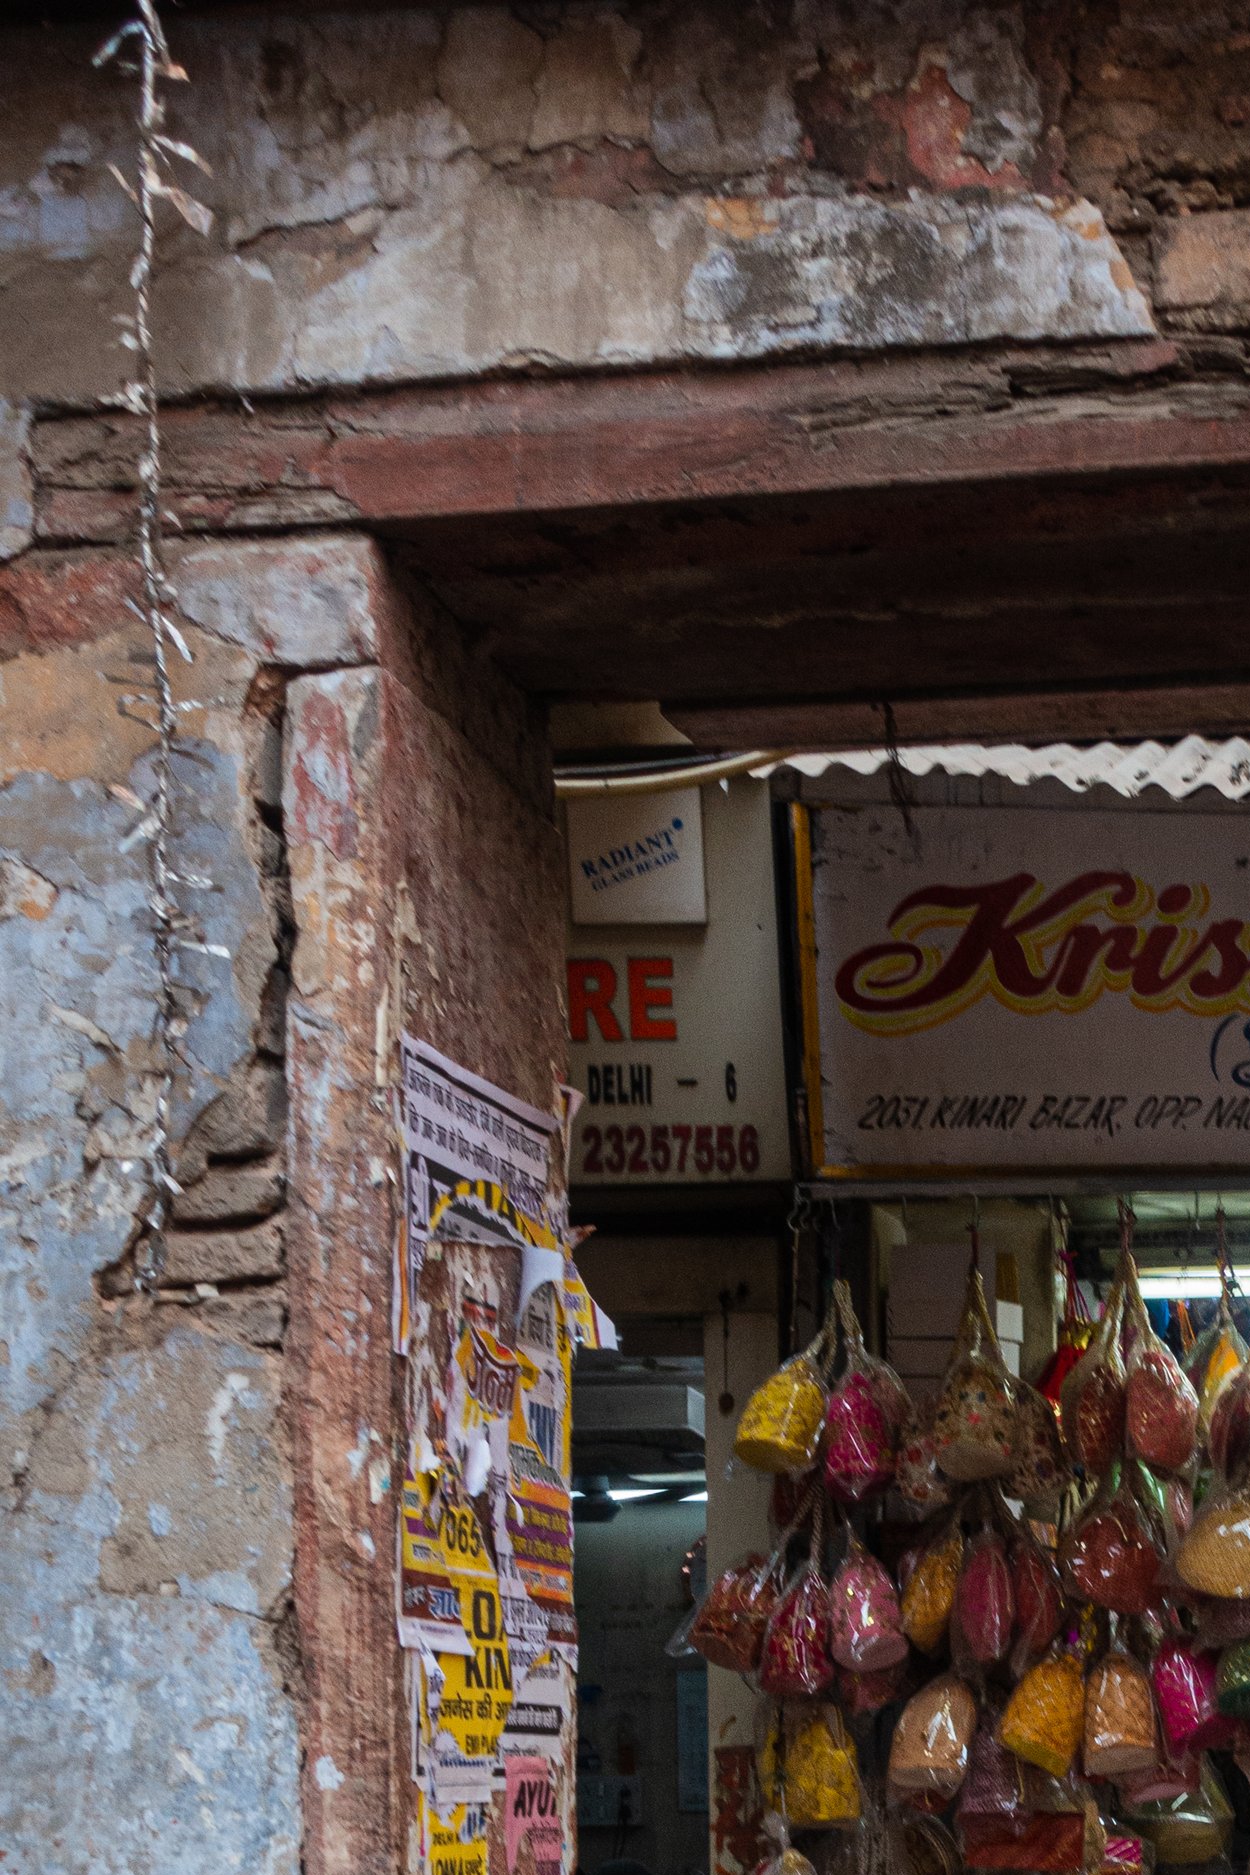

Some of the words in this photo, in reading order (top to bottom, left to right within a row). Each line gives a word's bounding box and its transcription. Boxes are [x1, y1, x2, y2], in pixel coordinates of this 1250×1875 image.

[581, 827, 674, 879] RADIANT
[587, 1063, 653, 1105] DELHI
[725, 1062, 738, 1103] 6
[929, 1093, 1027, 1131] KINARI
[582, 1124, 759, 1174] 23257556
[513, 1780, 557, 1818] AYU
